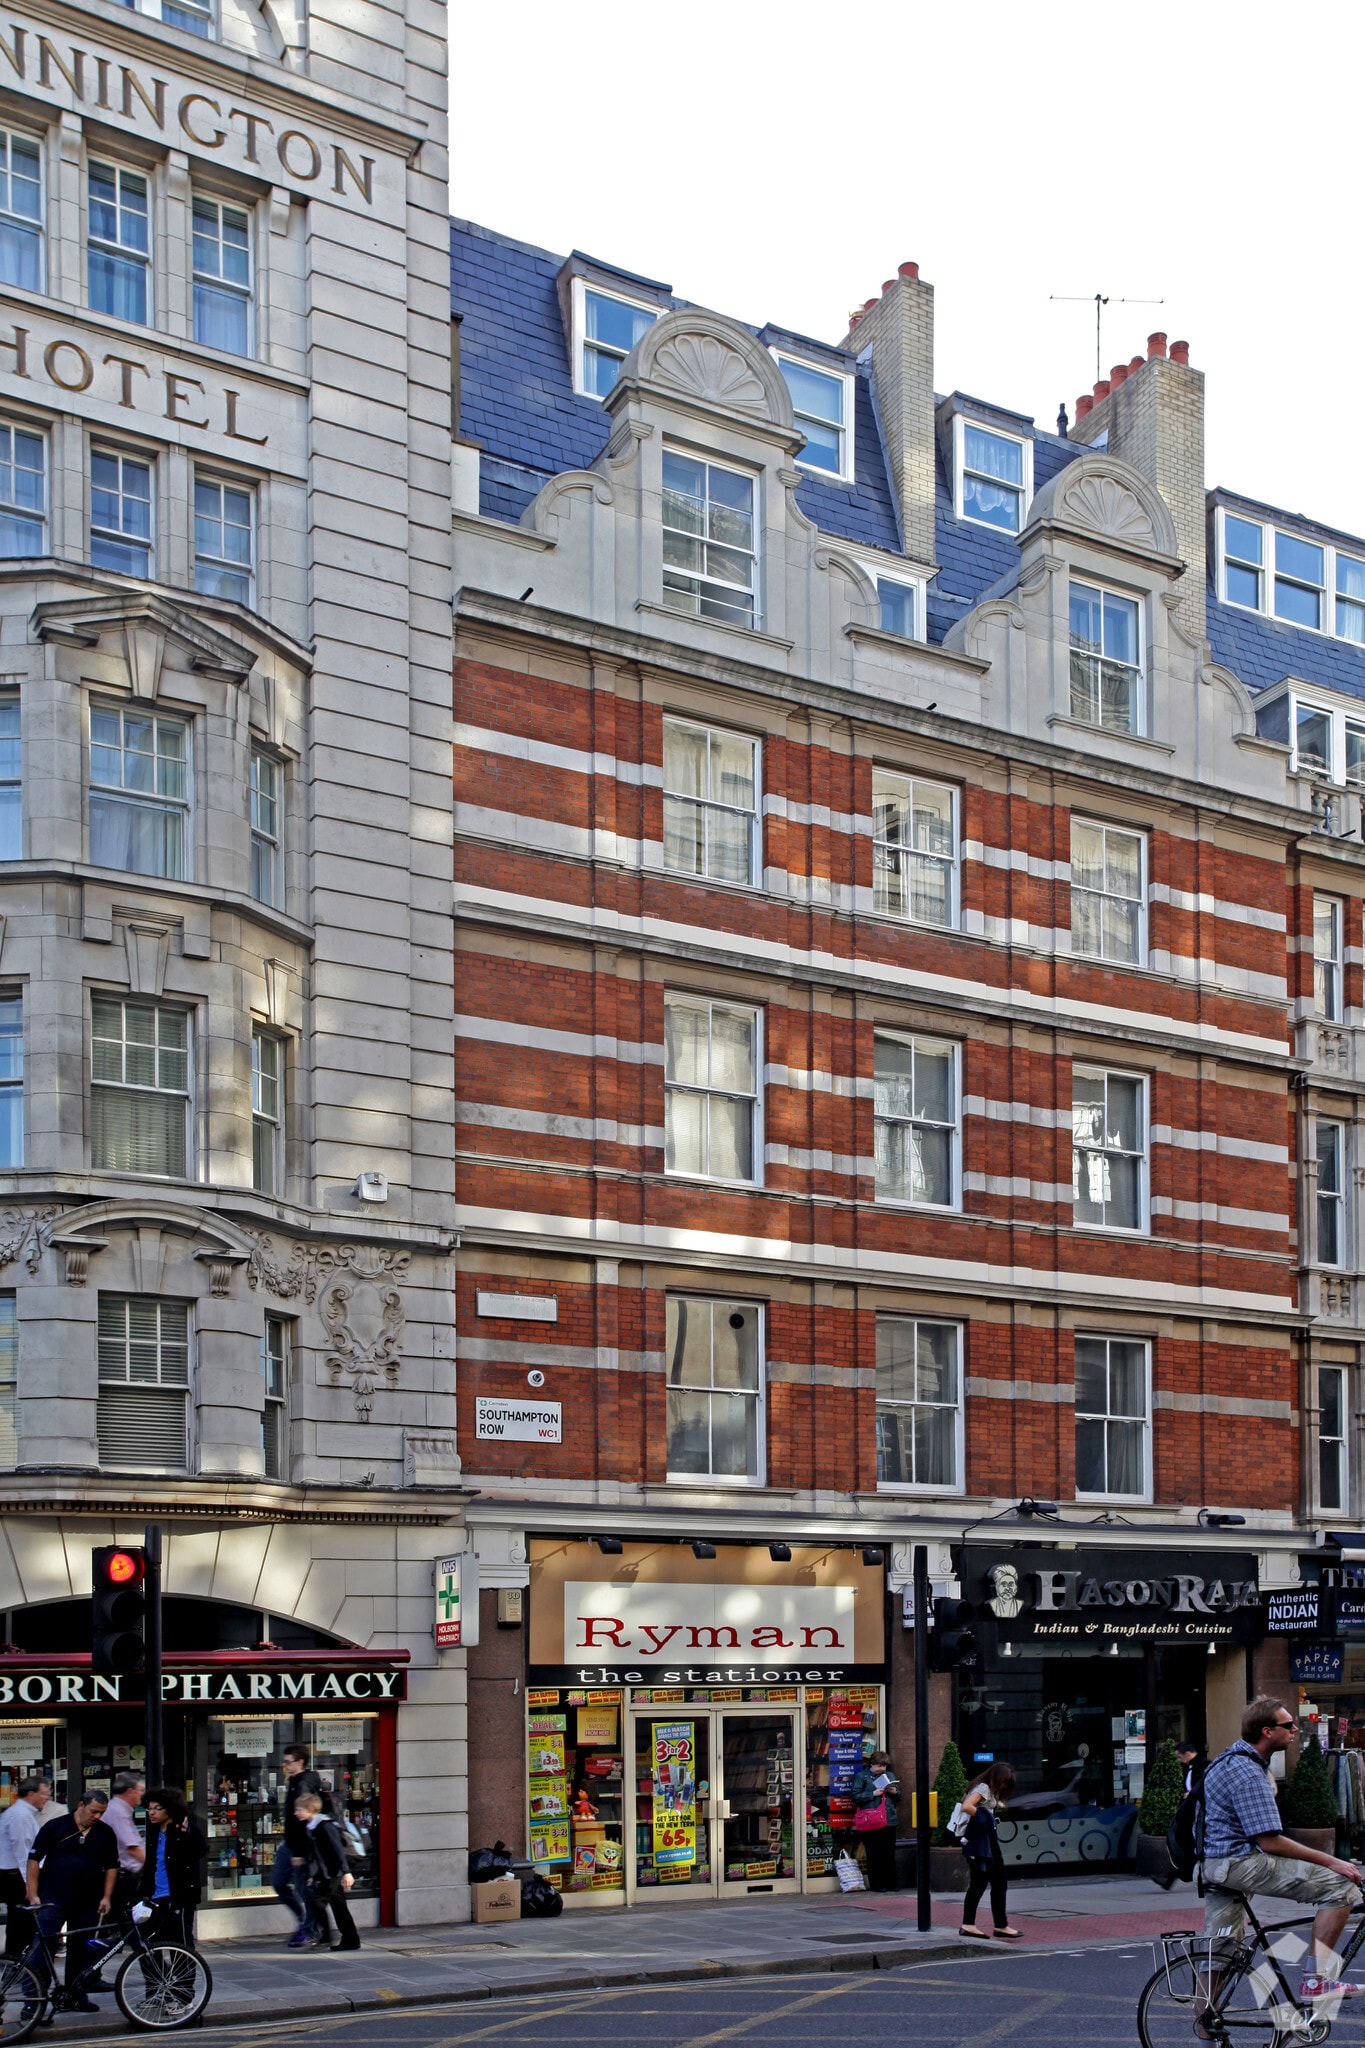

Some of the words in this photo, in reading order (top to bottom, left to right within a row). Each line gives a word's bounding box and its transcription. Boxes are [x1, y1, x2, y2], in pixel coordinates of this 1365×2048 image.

[479, 1409, 559, 1424] SOUTHAMPTON
[479, 1423, 504, 1435] ROW
[538, 1429, 558, 1438] WC1
[443, 1561, 456, 1574] NHS
[1269, 1593, 1319, 1604] Authentic
[1268, 1604, 1318, 1619] INDIAN
[439, 1624, 459, 1633] HOLBORN
[1033, 1623, 1079, 1634] Indian
[1085, 1624, 1098, 1633] &
[1103, 1623, 1179, 1637] Bangladeshi
[1185, 1623, 1233, 1634] Cuisine
[1269, 1620, 1317, 1630] Restaurant
[438, 1634, 460, 1643] PHARMACY
[575, 1616, 845, 1656] Ryman
[1295, 1653, 1340, 1668] PAPER
[577, 1668, 642, 1683] the
[663, 1667, 844, 1683] stationer
[161, 1672, 399, 1701] PHARMACY
[656, 1740, 668, 1760] 3
[667, 1745, 678, 1754] for
[677, 1739, 690, 1760] 2
[662, 1829, 691, 1846] 65p
[92, 1940, 125, 1970] ROCKRIDER
